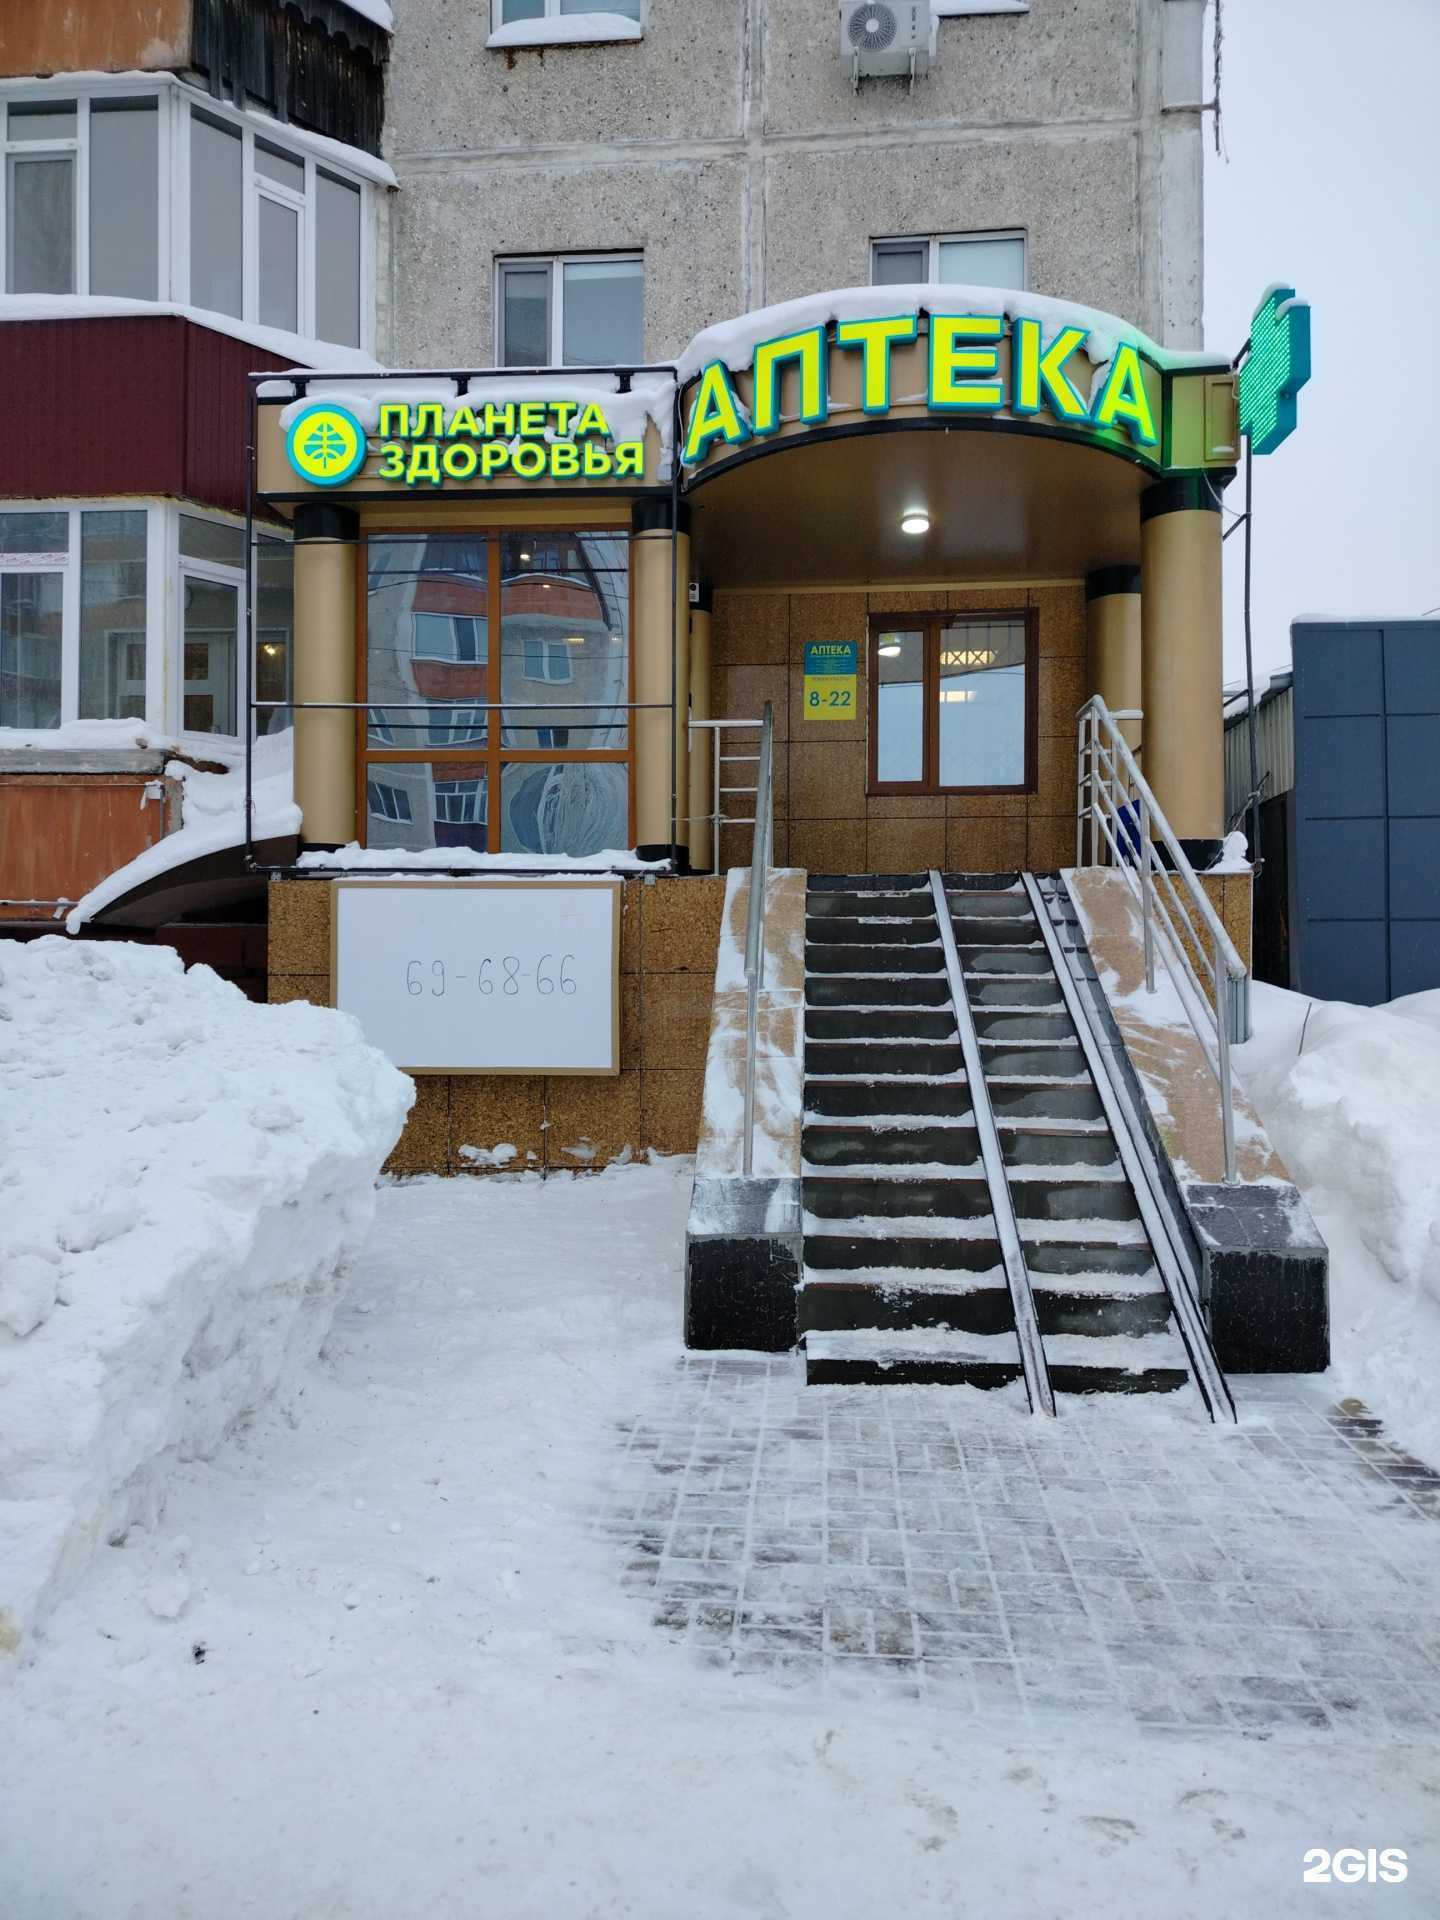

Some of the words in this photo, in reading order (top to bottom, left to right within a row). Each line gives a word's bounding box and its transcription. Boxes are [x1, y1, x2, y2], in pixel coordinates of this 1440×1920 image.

[682, 313, 1158, 464] АПТЕКА
[378, 401, 613, 440] ПЛАНЕТА
[378, 440, 646, 486] ЗДОРОВЬЯ
[810, 644, 851, 655] АПТЕКА
[809, 690, 851, 707] 8-22
